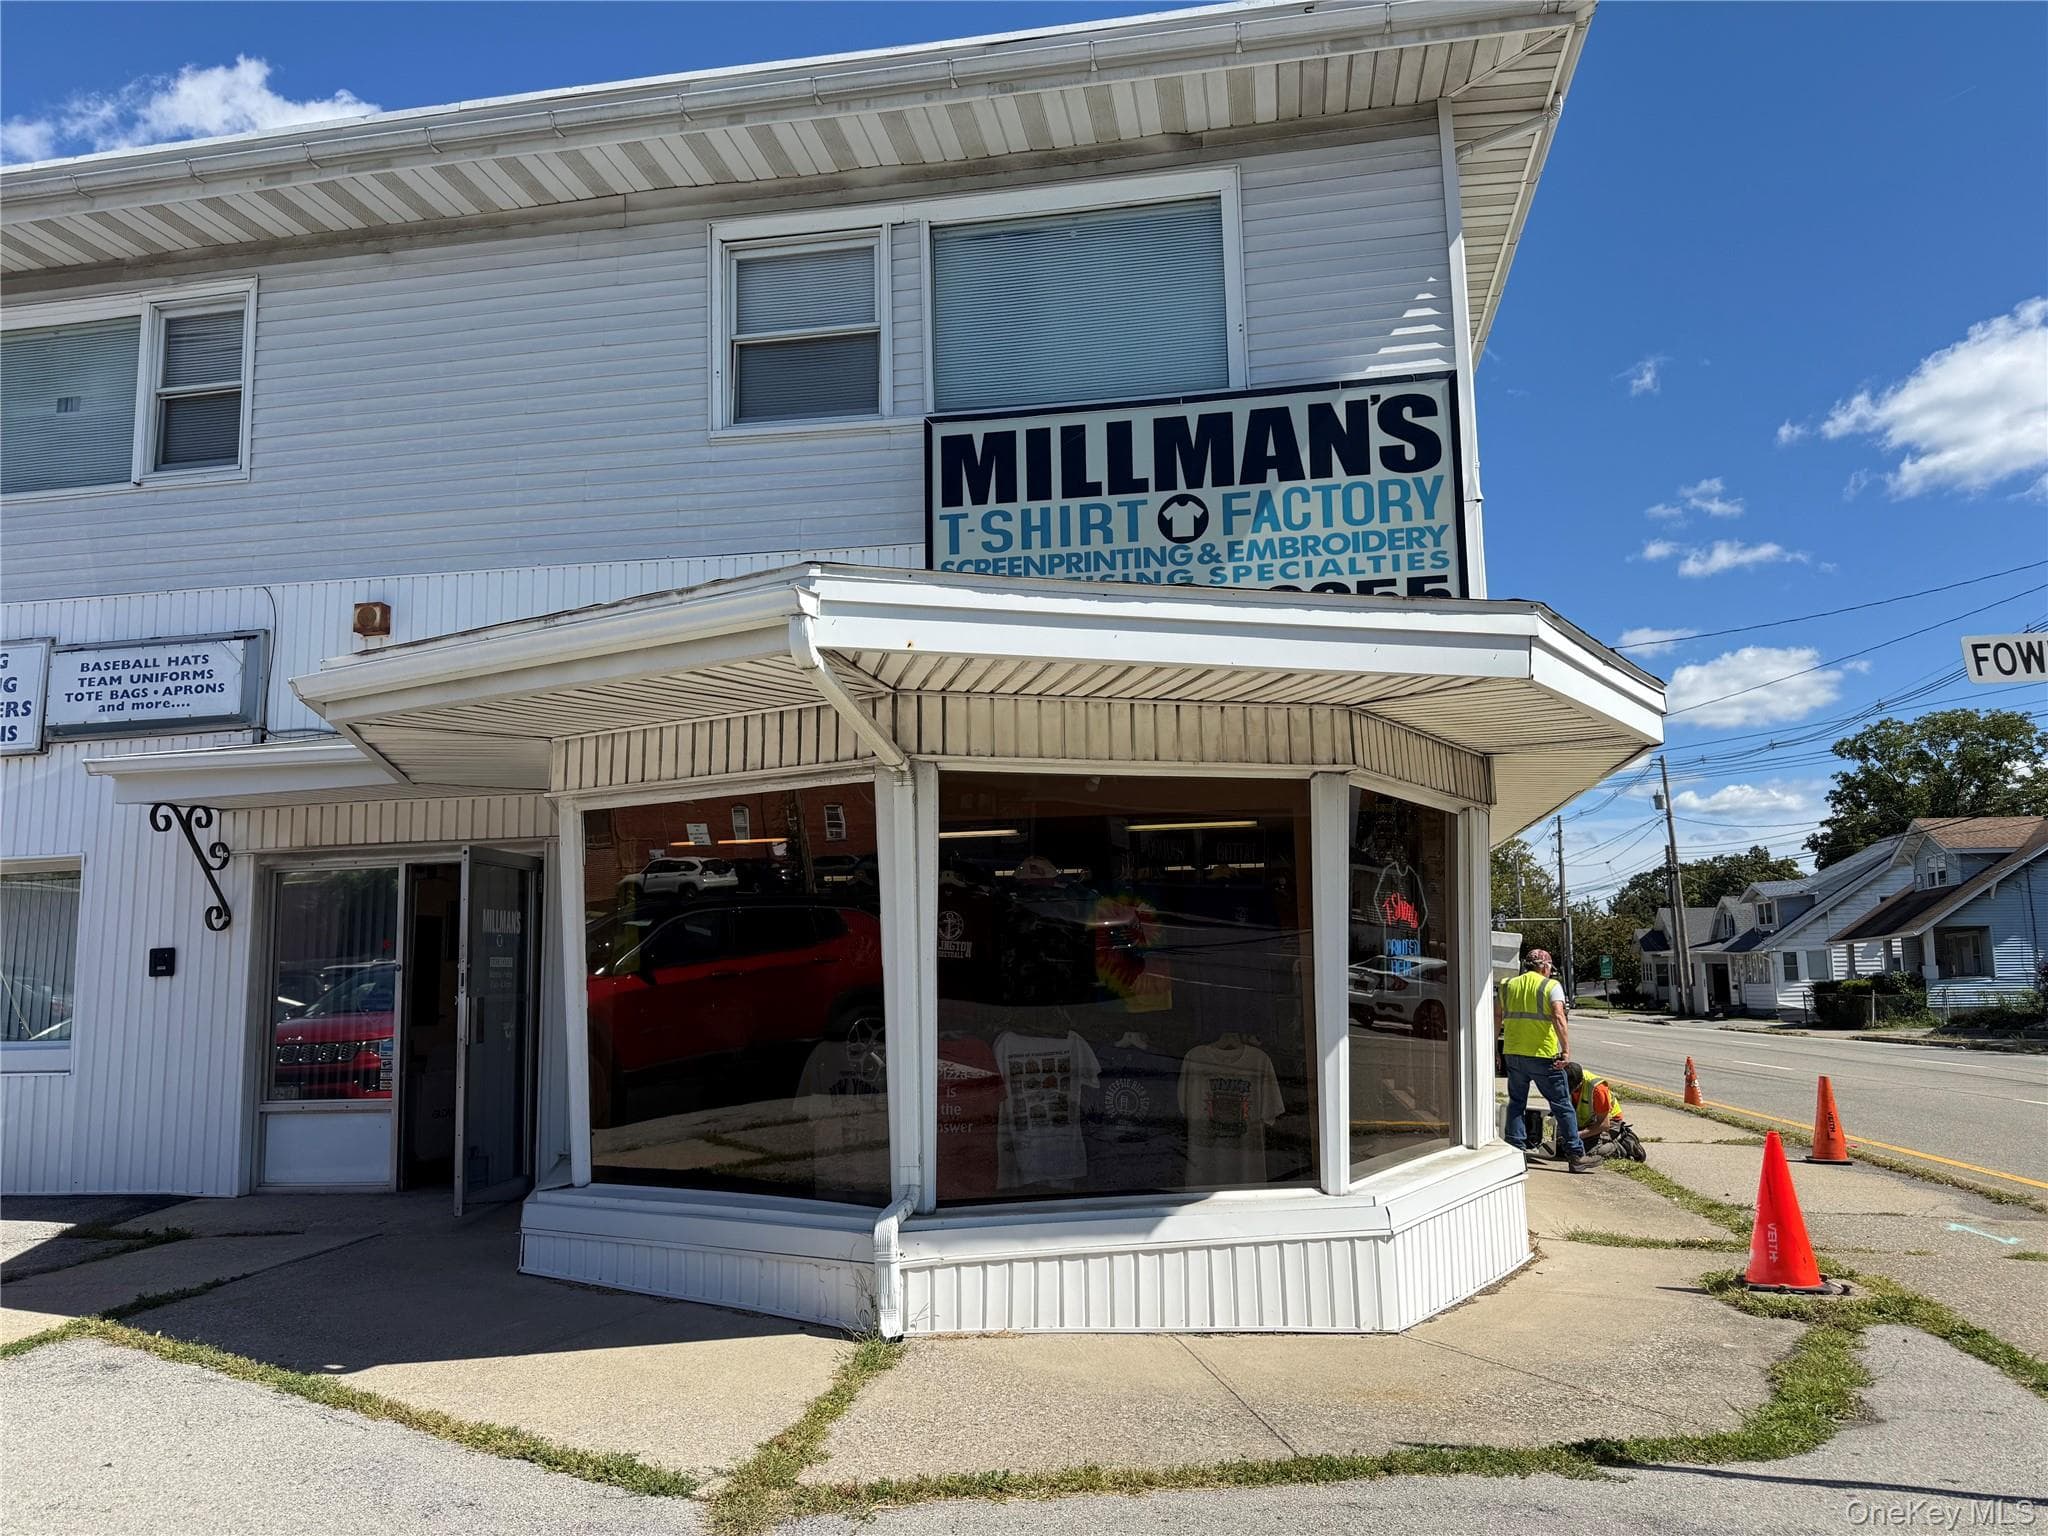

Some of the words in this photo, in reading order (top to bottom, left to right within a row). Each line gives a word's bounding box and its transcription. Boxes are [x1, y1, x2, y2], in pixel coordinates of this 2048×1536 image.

[940, 393, 1443, 508] MILLMAN'S
[939, 499, 1148, 555] T-SHIRT
[1221, 474, 1445, 536] FACTORY
[1197, 543, 1224, 566] &
[1227, 525, 1449, 564] EMBROIDERY
[1208, 550, 1450, 585] SPECIALTIES
[80, 657, 161, 673] BASEBALL
[167, 654, 210, 667] HATS
[1971, 640, 2048, 676] FOW
[65, 690, 103, 702] TOTE
[109, 686, 149, 700] BAGS
[162, 682, 226, 697] APRONS
[78, 676, 122, 688] TEAM
[129, 669, 215, 684] UNIFORMS
[98, 700, 125, 712] and
